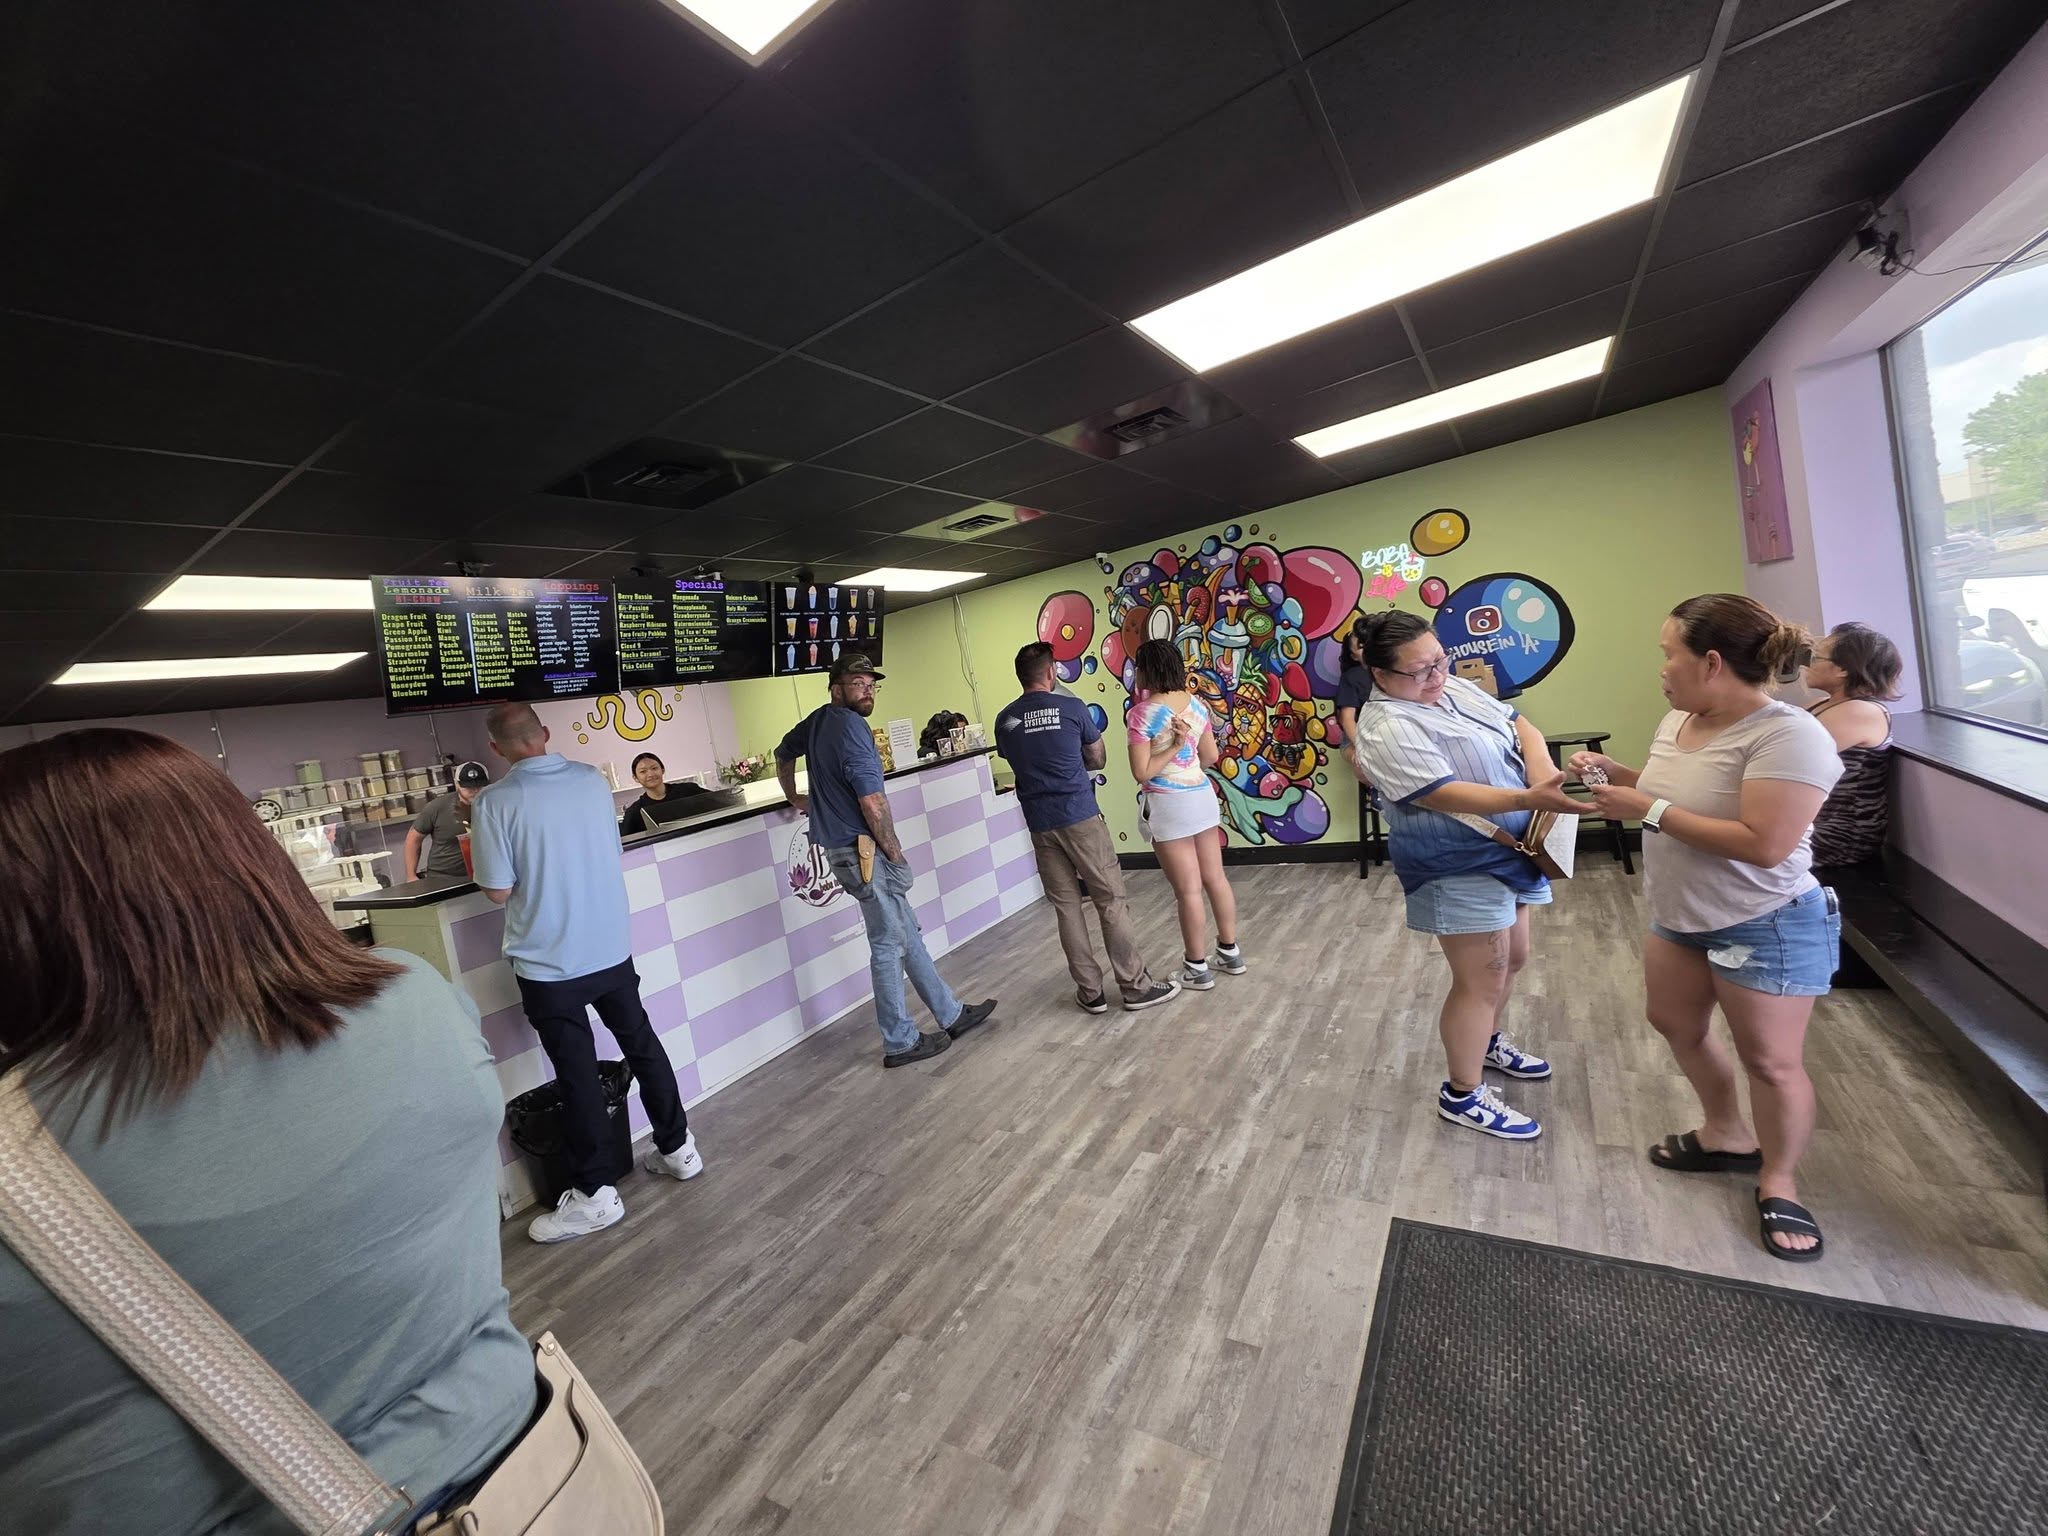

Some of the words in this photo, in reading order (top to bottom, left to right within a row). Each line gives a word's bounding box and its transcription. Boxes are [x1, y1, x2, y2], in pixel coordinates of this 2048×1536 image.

[1361, 543, 1409, 569] BOBA
[544, 581, 600, 592] Toppings
[675, 580, 724, 590] Specials
[1365, 573, 1408, 602] Life
[384, 586, 449, 594] Lemonade
[466, 586, 502, 596] Milk
[511, 587, 534, 596] Tea
[381, 613, 408, 621] Dragon
[476, 660, 507, 668] Chocolate
[442, 671, 472, 679] Kumquat
[477, 667, 515, 675] Wintermelon
[391, 681, 427, 689] Honeydew
[479, 680, 515, 689] Watermelon
[392, 689, 428, 697] Blueberry
[1024, 708, 1060, 720] ELECTRONIC
[1024, 716, 1052, 728] SYSTEMS
